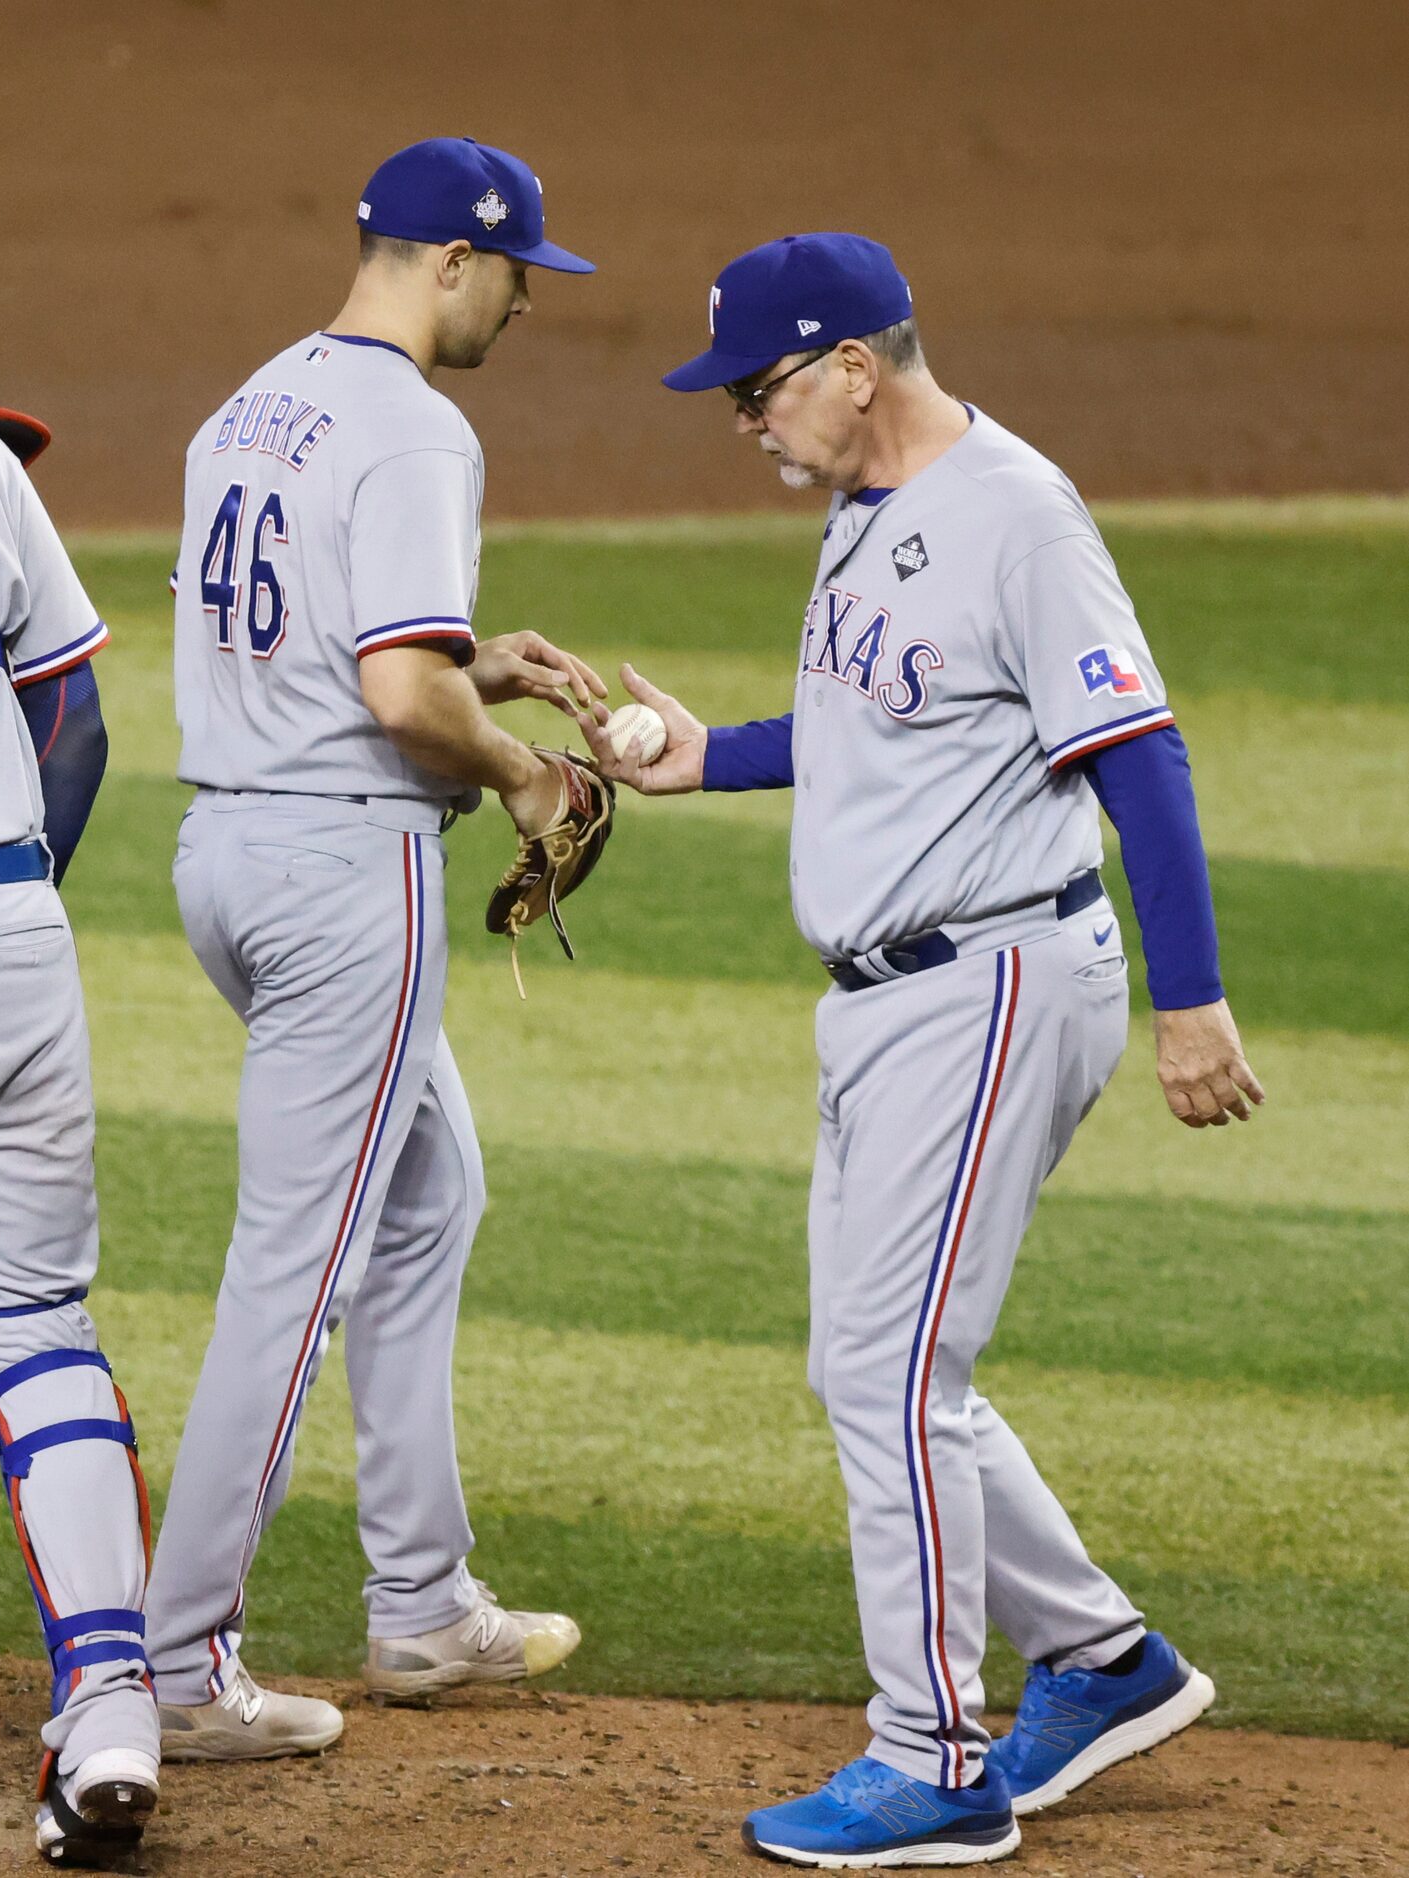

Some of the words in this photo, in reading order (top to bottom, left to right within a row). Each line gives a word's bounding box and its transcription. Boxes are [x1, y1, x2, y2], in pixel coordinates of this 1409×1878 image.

[475, 202, 507, 211] WORLD
[475, 209, 507, 220] SERIES
[213, 390, 335, 472] BURKE
[893, 553, 923, 570] SERIES
[897, 545, 925, 562] WORLD
[201, 480, 289, 660] 46
[802, 586, 943, 720] EXAS
